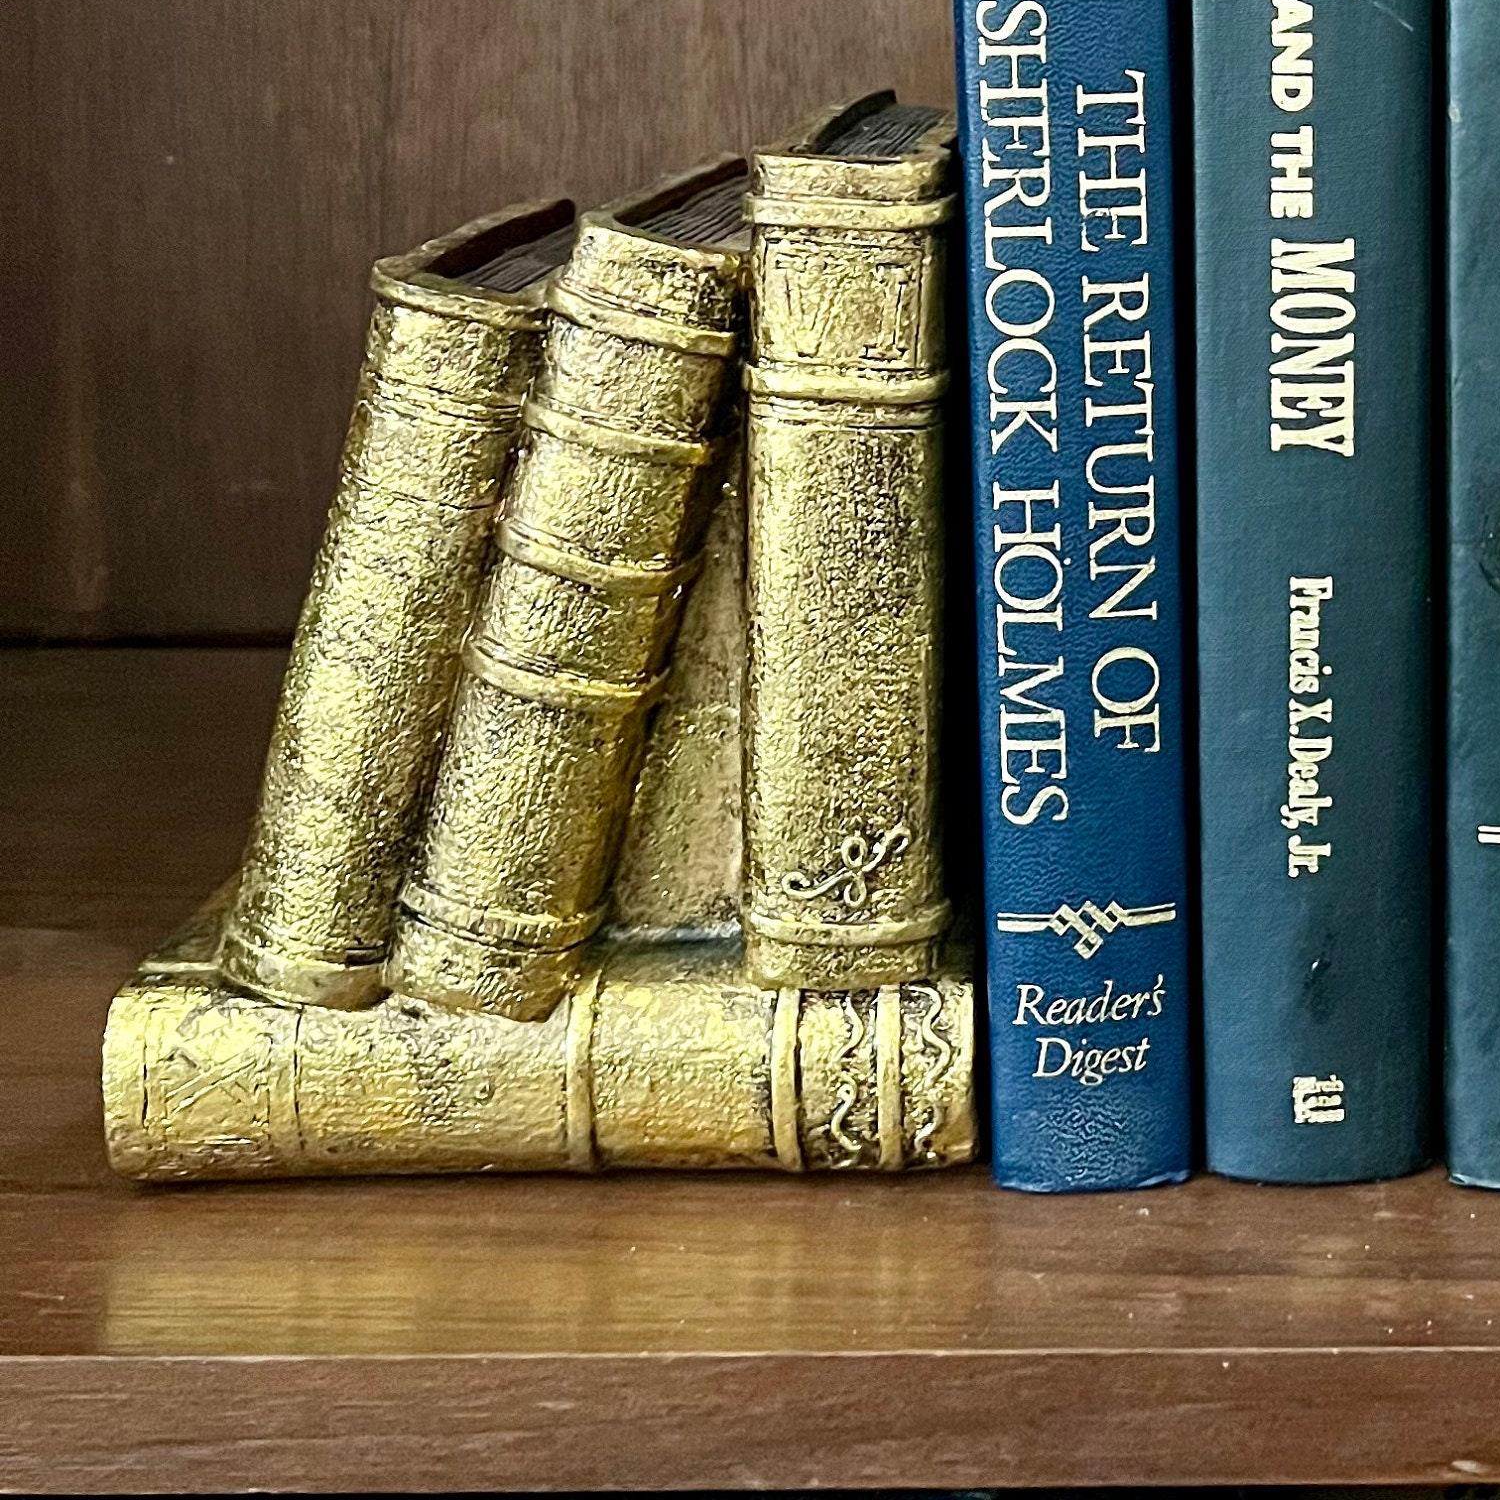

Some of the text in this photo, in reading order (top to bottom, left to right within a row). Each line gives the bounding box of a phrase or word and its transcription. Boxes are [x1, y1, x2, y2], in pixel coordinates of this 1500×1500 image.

[1270, 125, 1314, 219] THE
[1268, 238, 1357, 457] MONEY
[975, 0, 1069, 826] SHERLOCK HOLMES
[1076, 69, 1161, 753] THE RETURN OF
[1289, 576, 1333, 694] Francis
[1288, 834, 1332, 878] Jr.
[1012, 974, 1166, 1025] Reader's
[1032, 1037, 1151, 1086] Digest
